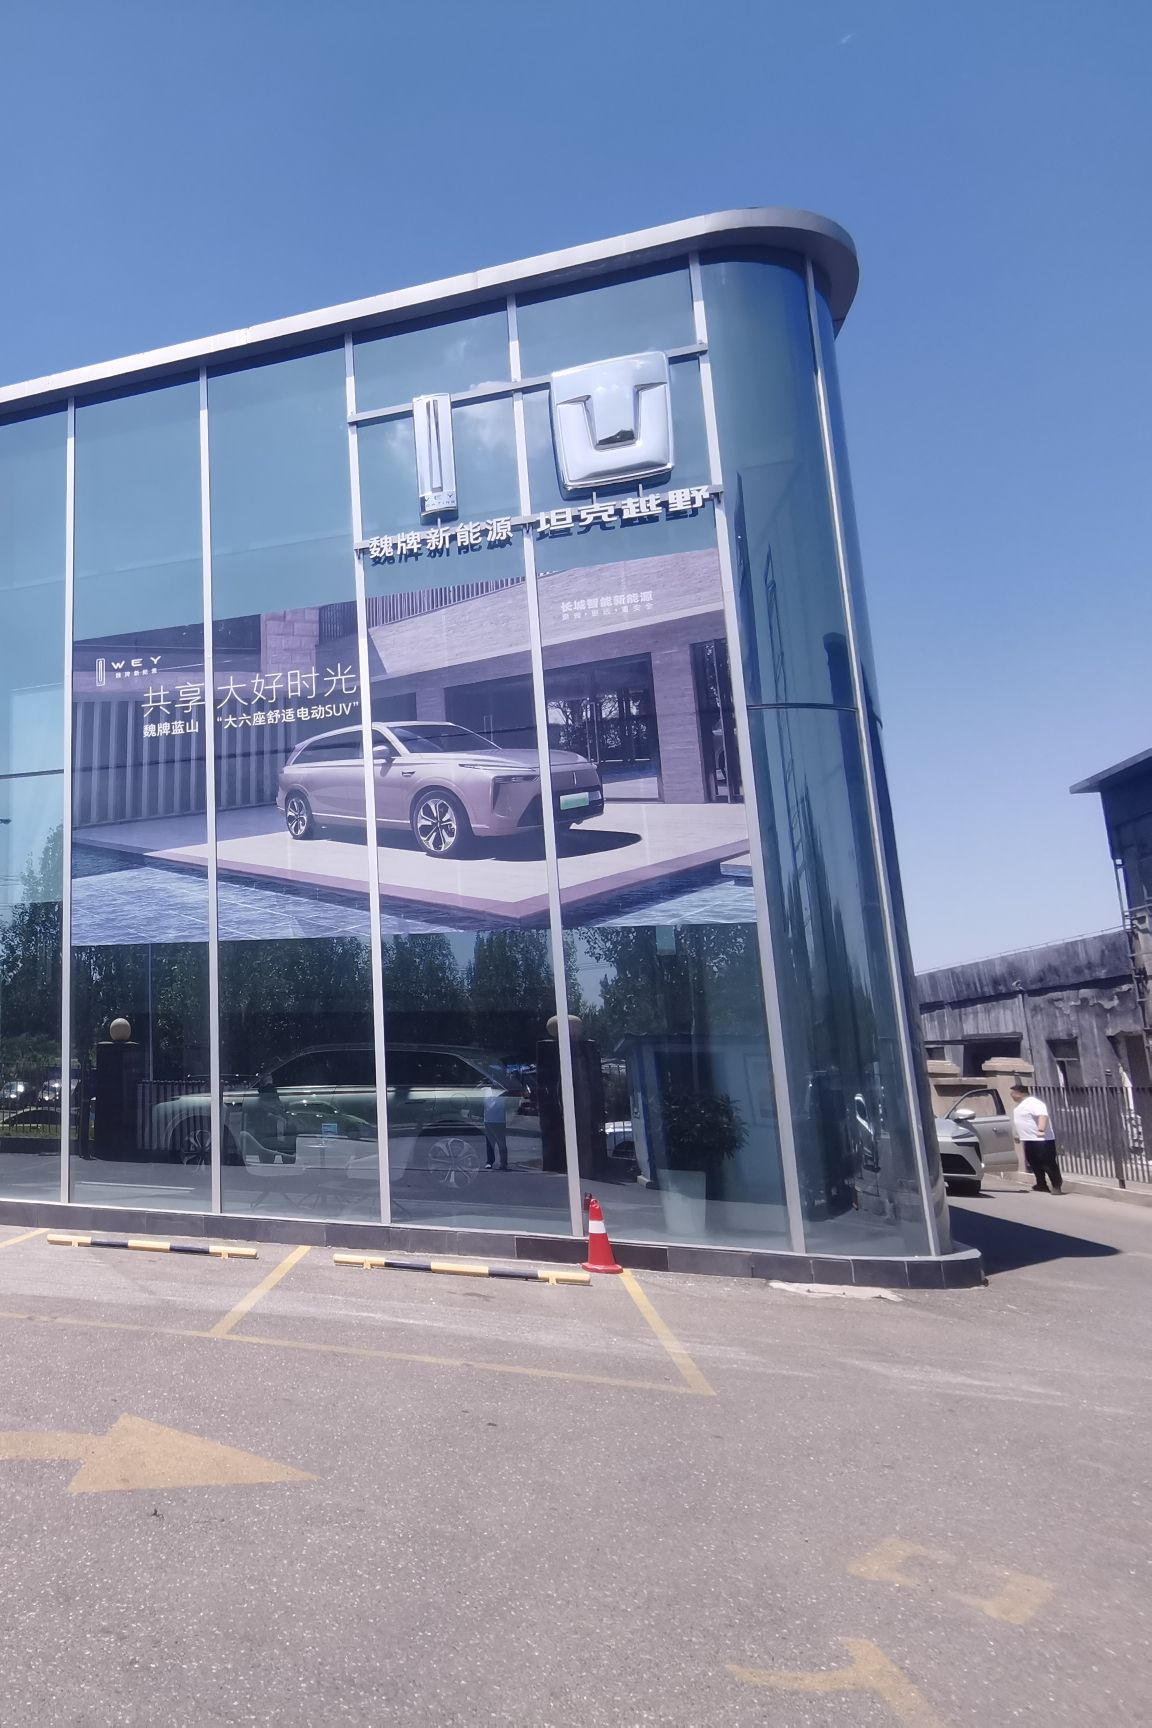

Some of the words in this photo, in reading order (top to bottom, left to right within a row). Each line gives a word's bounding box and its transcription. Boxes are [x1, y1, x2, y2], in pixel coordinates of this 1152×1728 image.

[536, 487, 712, 532] 坦克越野
[368, 517, 514, 559] 魏牌新能源
[111, 655, 162, 670] WEY
[141, 662, 358, 718] 共享大好时光
[143, 719, 199, 738] 魏牌蓝山
